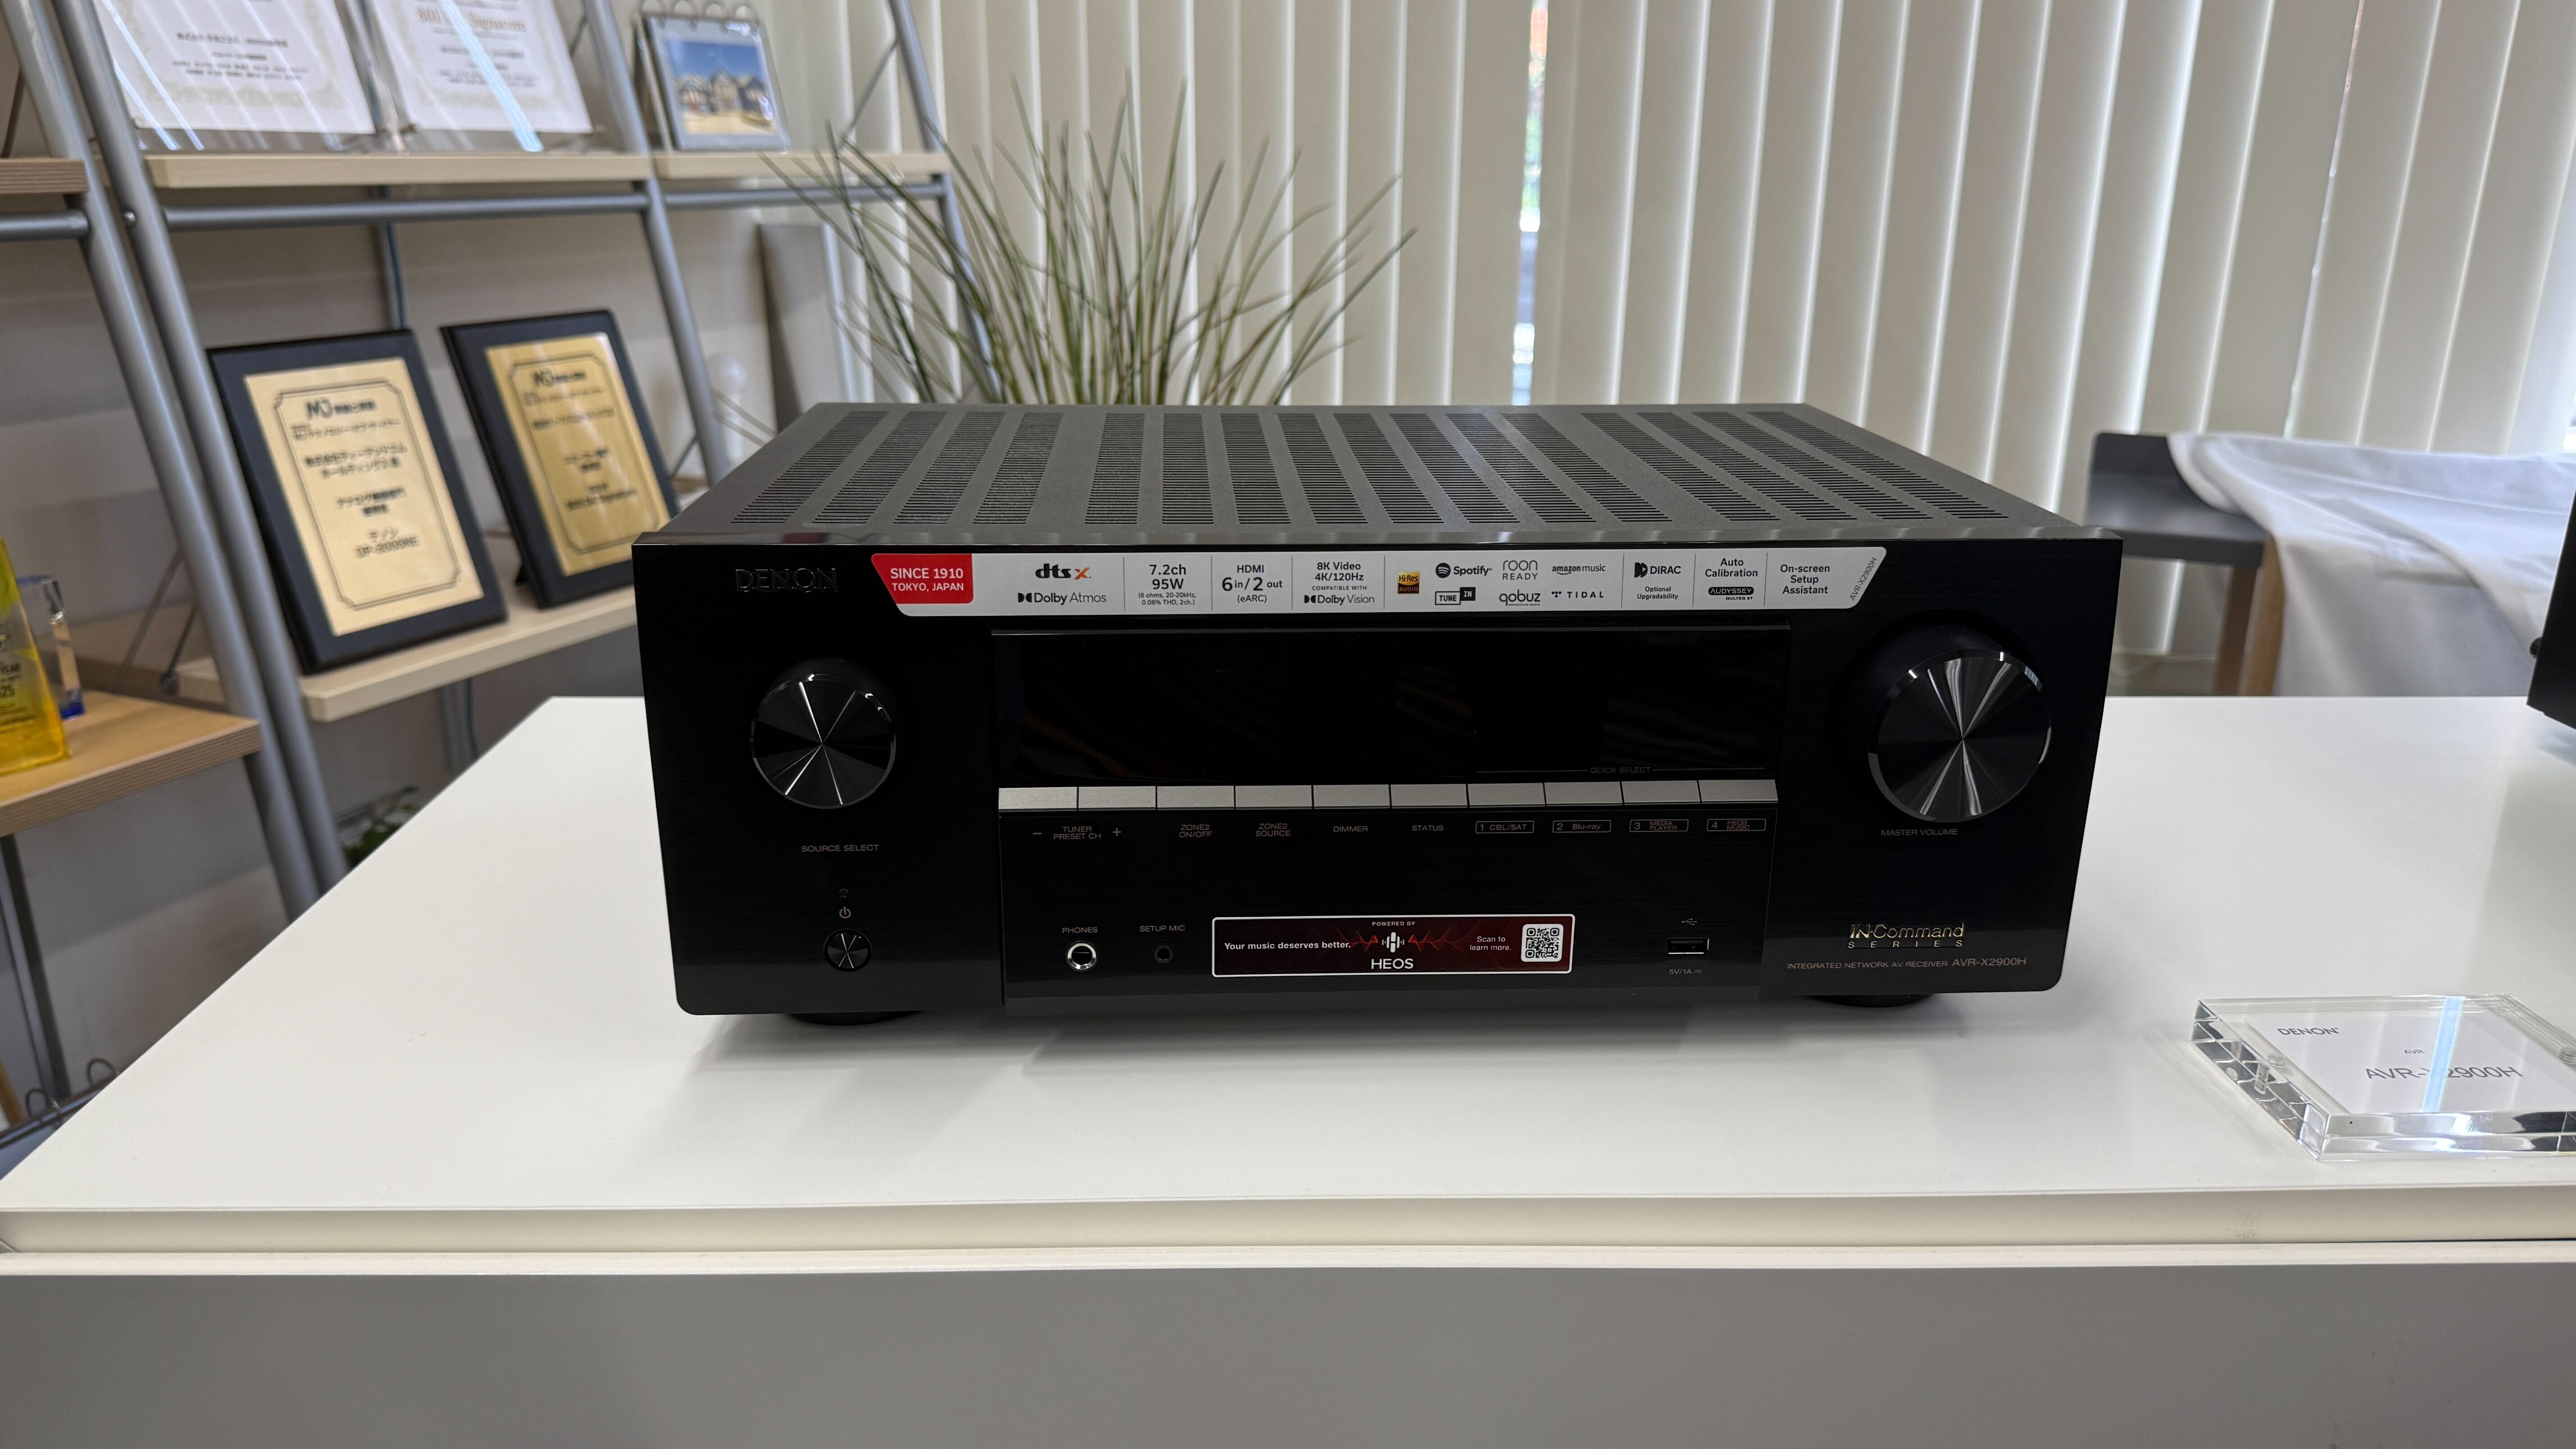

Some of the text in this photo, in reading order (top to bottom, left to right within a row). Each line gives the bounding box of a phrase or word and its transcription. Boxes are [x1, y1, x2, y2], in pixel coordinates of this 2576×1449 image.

[1317, 561, 1361, 570] 8K Video
[1503, 560, 1538, 571] roon
[1720, 558, 1744, 566] Auto
[890, 567, 964, 579] SINCE 1910
[1035, 563, 1071, 579] dts
[1149, 564, 1187, 575] 7.2ch
[1237, 565, 1265, 573] HDMI
[1454, 566, 1489, 577] Spotify
[1650, 566, 1682, 575] DIRAC
[1705, 568, 1758, 577] Calibration
[1780, 564, 1830, 573] On-screen
[735, 568, 838, 592] DENON
[1315, 573, 1364, 581] 4K/120Hz
[1790, 575, 1819, 585] Setup
[1849, 557, 1877, 601] AVR-X2900H
[892, 582, 964, 592] TOKYO, JAPAN
[1152, 578, 1184, 590] 95W
[1222, 577, 1233, 591] 6
[1253, 577, 1263, 591] 2
[1267, 580, 1283, 588] out
[1782, 586, 1828, 594] Assistant
[1034, 592, 1107, 605] Dolby Atmos
[1237, 594, 1267, 603] (eARC)
[1317, 594, 1375, 606] Dolby Vision
[1499, 589, 1541, 607] qobuz
[1572, 823, 1601, 831] Blu-ray
[1634, 822, 1641, 830] 3
[1848, 940, 1963, 948] SERIES
[1371, 958, 1414, 970] HEOS
[1951, 957, 2027, 966] AVR-X2900H
[2277, 1028, 2339, 1036] DENON
[2365, 1066, 2523, 1080] AVR-2900H
